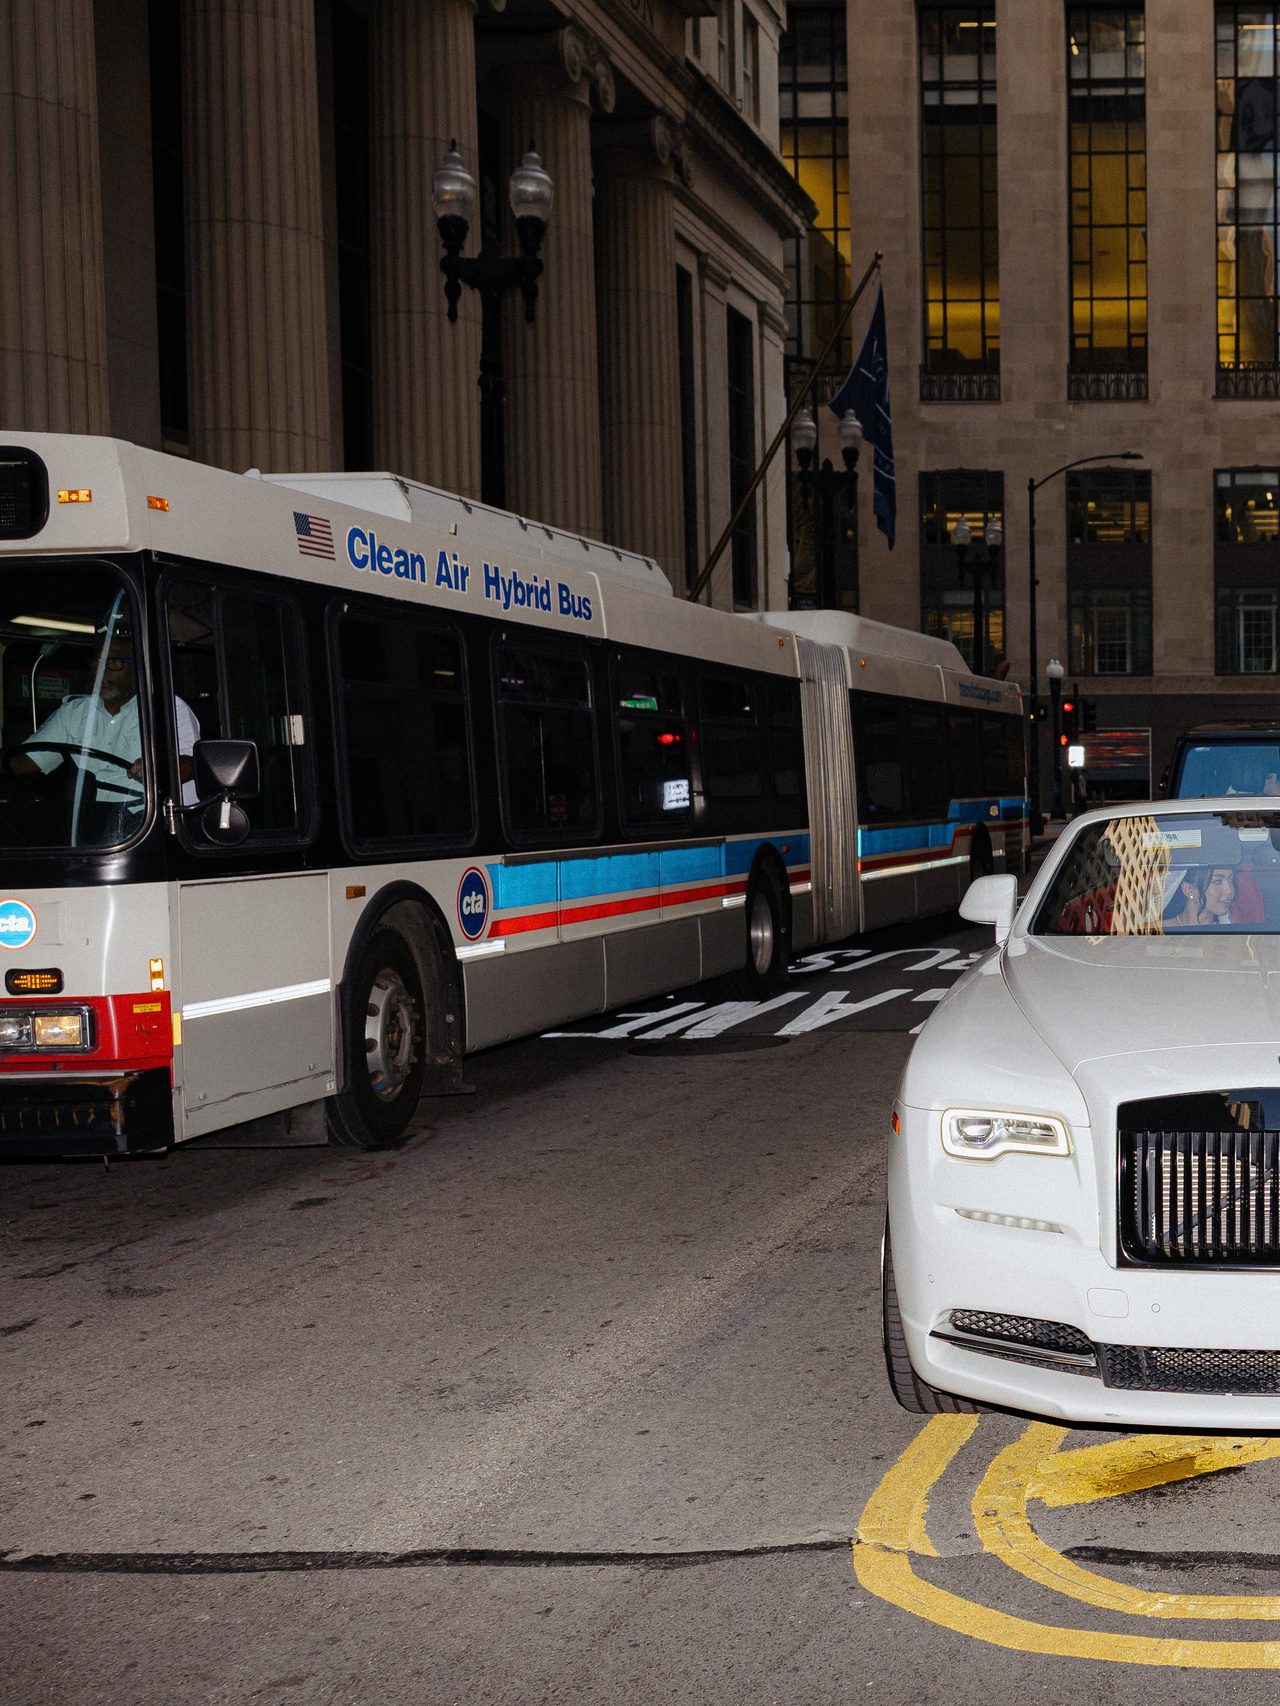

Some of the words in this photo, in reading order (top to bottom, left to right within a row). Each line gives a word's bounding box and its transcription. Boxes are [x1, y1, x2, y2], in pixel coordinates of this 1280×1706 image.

[347, 527, 427, 583] Clean
[435, 550, 470, 592] Air
[483, 563, 551, 611] Hybrid
[557, 582, 593, 620] Bus
[462, 891, 484, 915] cta
[0, 914, 29, 932] cta
